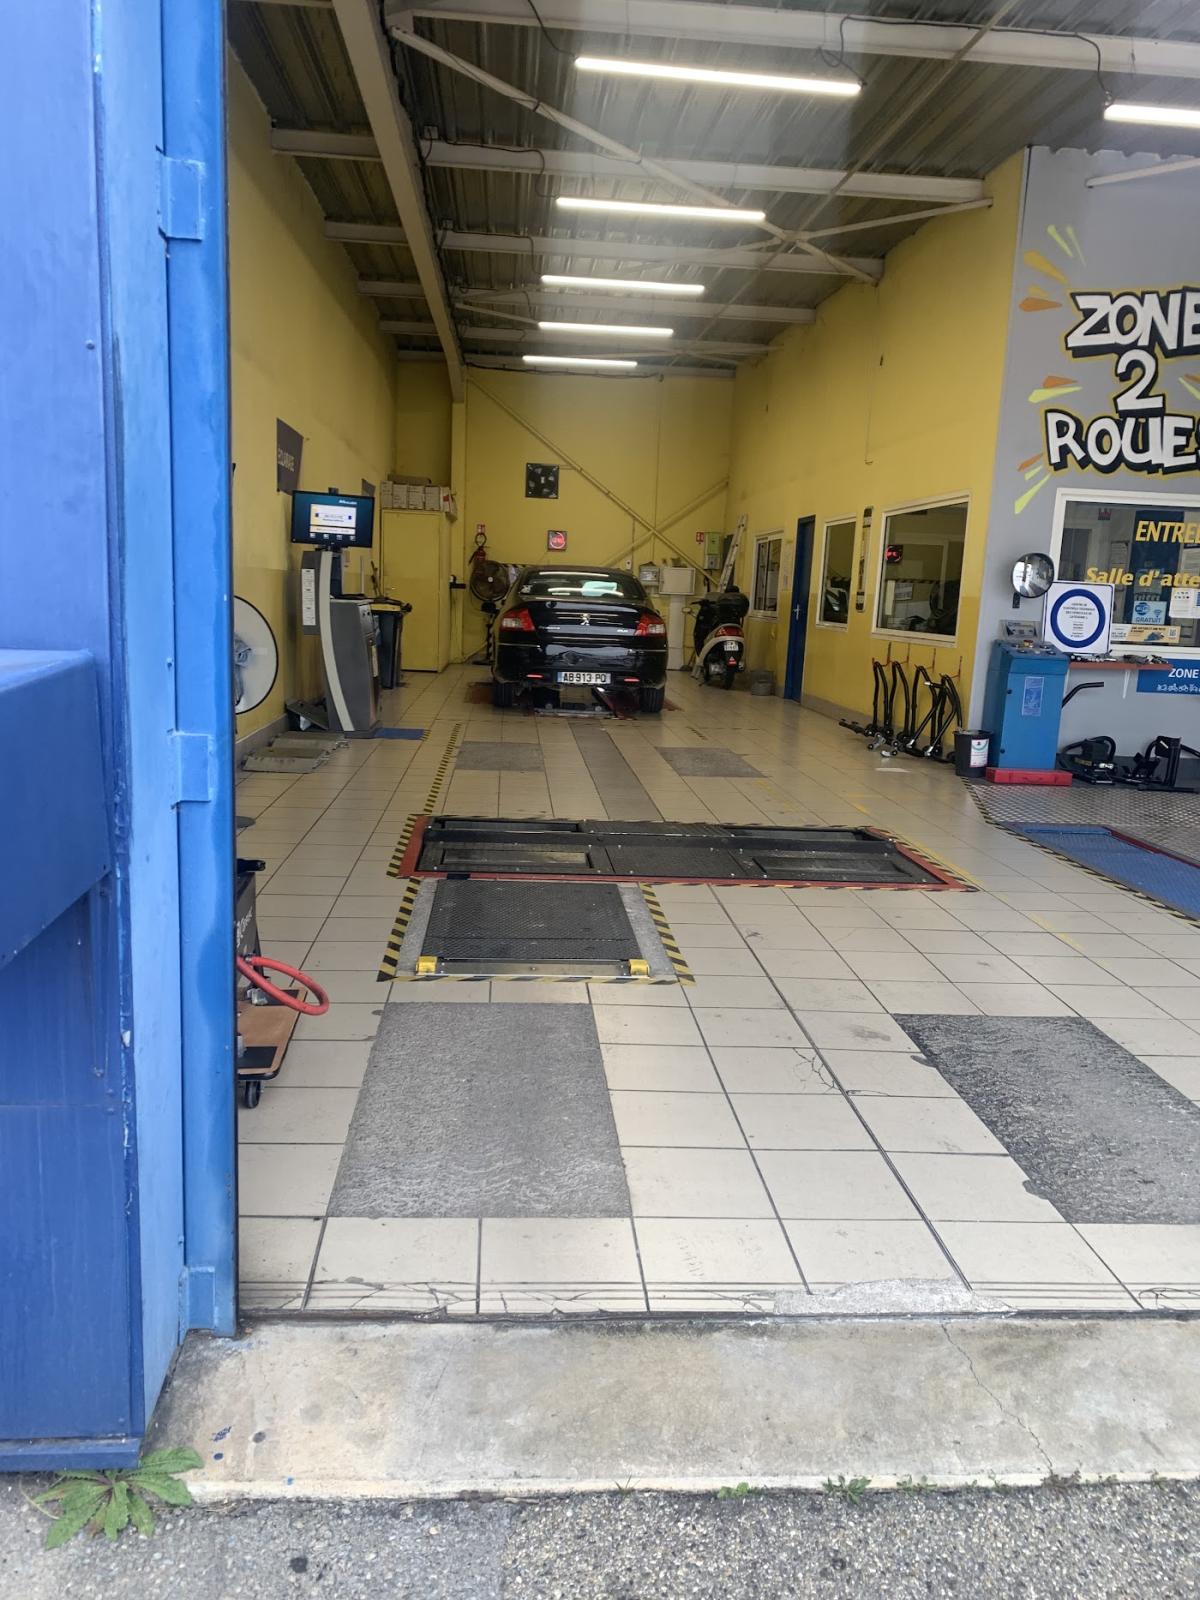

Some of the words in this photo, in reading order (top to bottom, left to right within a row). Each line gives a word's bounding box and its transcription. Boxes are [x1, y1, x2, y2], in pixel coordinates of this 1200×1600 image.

[1065, 287, 1200, 357] ZONE
[1114, 348, 1166, 415] 2
[1045, 409, 1200, 473] ROUE
[1086, 567, 1133, 586] Salle
[1168, 668, 1200, 679] ZONE
